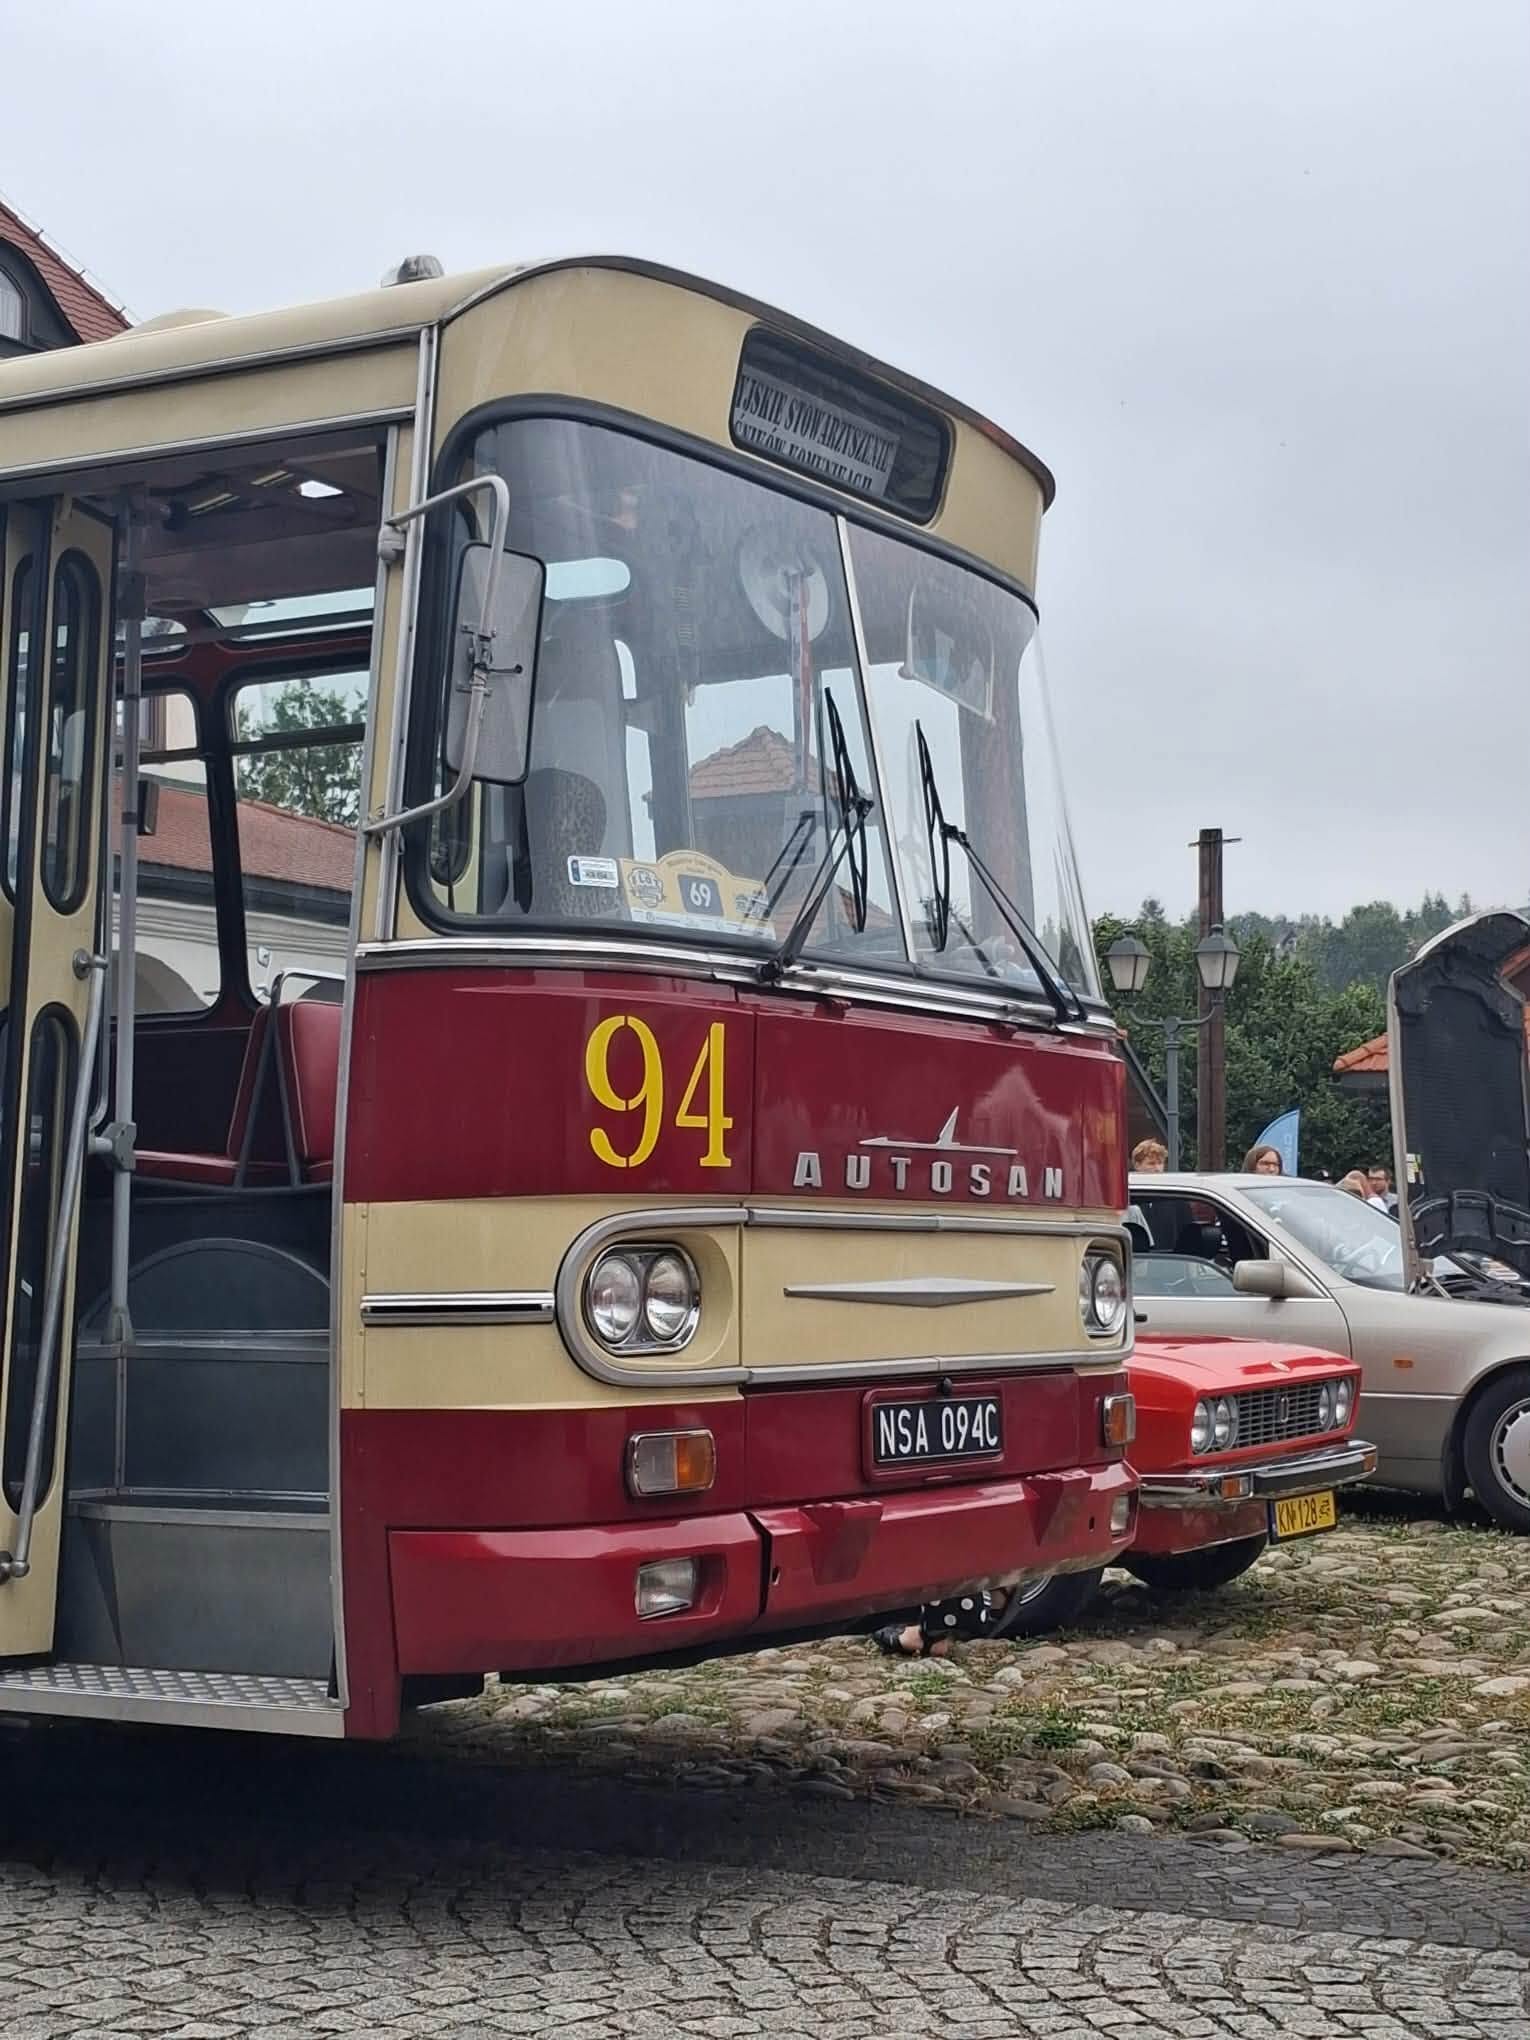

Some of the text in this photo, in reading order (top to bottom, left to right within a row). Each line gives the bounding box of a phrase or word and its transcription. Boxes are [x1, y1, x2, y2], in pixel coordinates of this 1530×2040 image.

[690, 881, 712, 908] 69
[584, 1015, 733, 1168] 94
[793, 1152, 1062, 1198] AUTOSAN
[879, 1402, 998, 1457] NSA 094C
